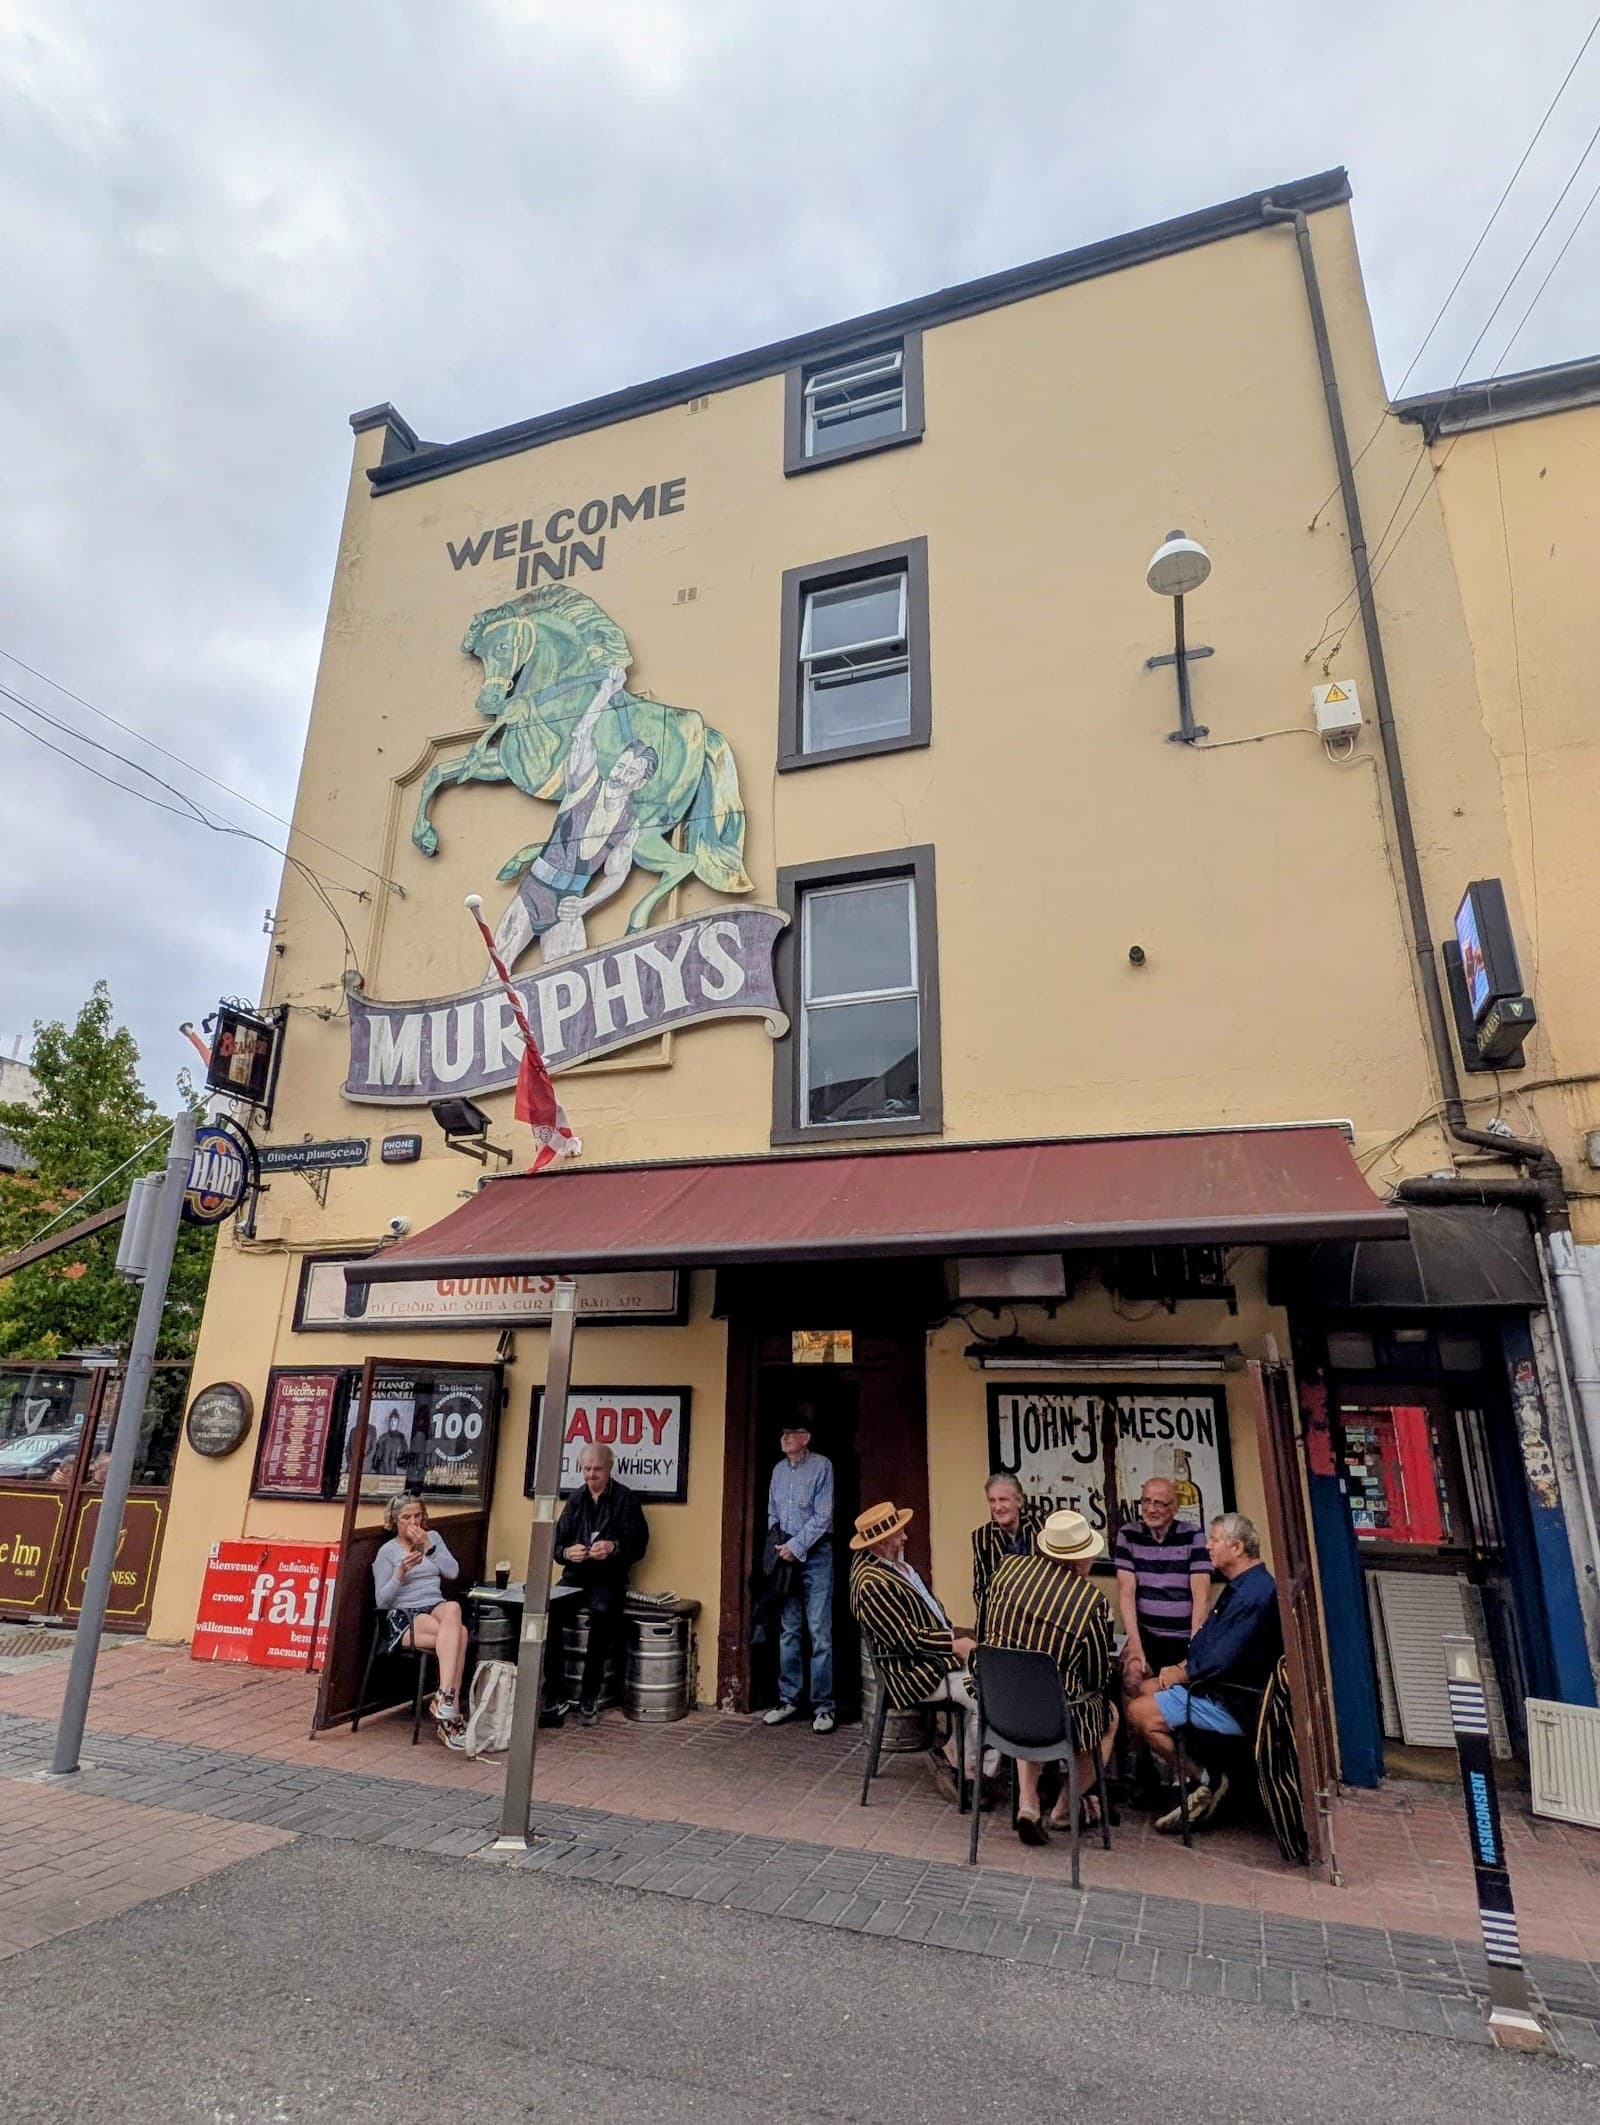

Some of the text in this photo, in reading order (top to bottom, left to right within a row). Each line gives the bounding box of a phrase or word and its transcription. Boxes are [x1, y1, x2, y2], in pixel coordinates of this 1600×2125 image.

[446, 477, 687, 571] WELCOME
[516, 535, 606, 590] INN
[365, 919, 746, 1085] MURPHYS
[383, 1139, 414, 1150] PHONE
[188, 1150, 241, 1196] HARP
[282, 1385, 328, 1397] Welcome Inn
[432, 1412, 483, 1440] 100
[563, 1407, 673, 1446] ADDY
[1000, 1399, 1214, 1474] JOHN JMESON
[617, 1456, 673, 1475] WHISKY
[11, 1534, 41, 1566] Inn
[209, 1559, 259, 1573] bienvenue
[81, 1566, 137, 1586] GNESS
[212, 1592, 245, 1603] croeso
[247, 1573, 336, 1627] fáil
[196, 1620, 254, 1637] välkommen
[1470, 1771, 1497, 1864] #ASKCONSENT
